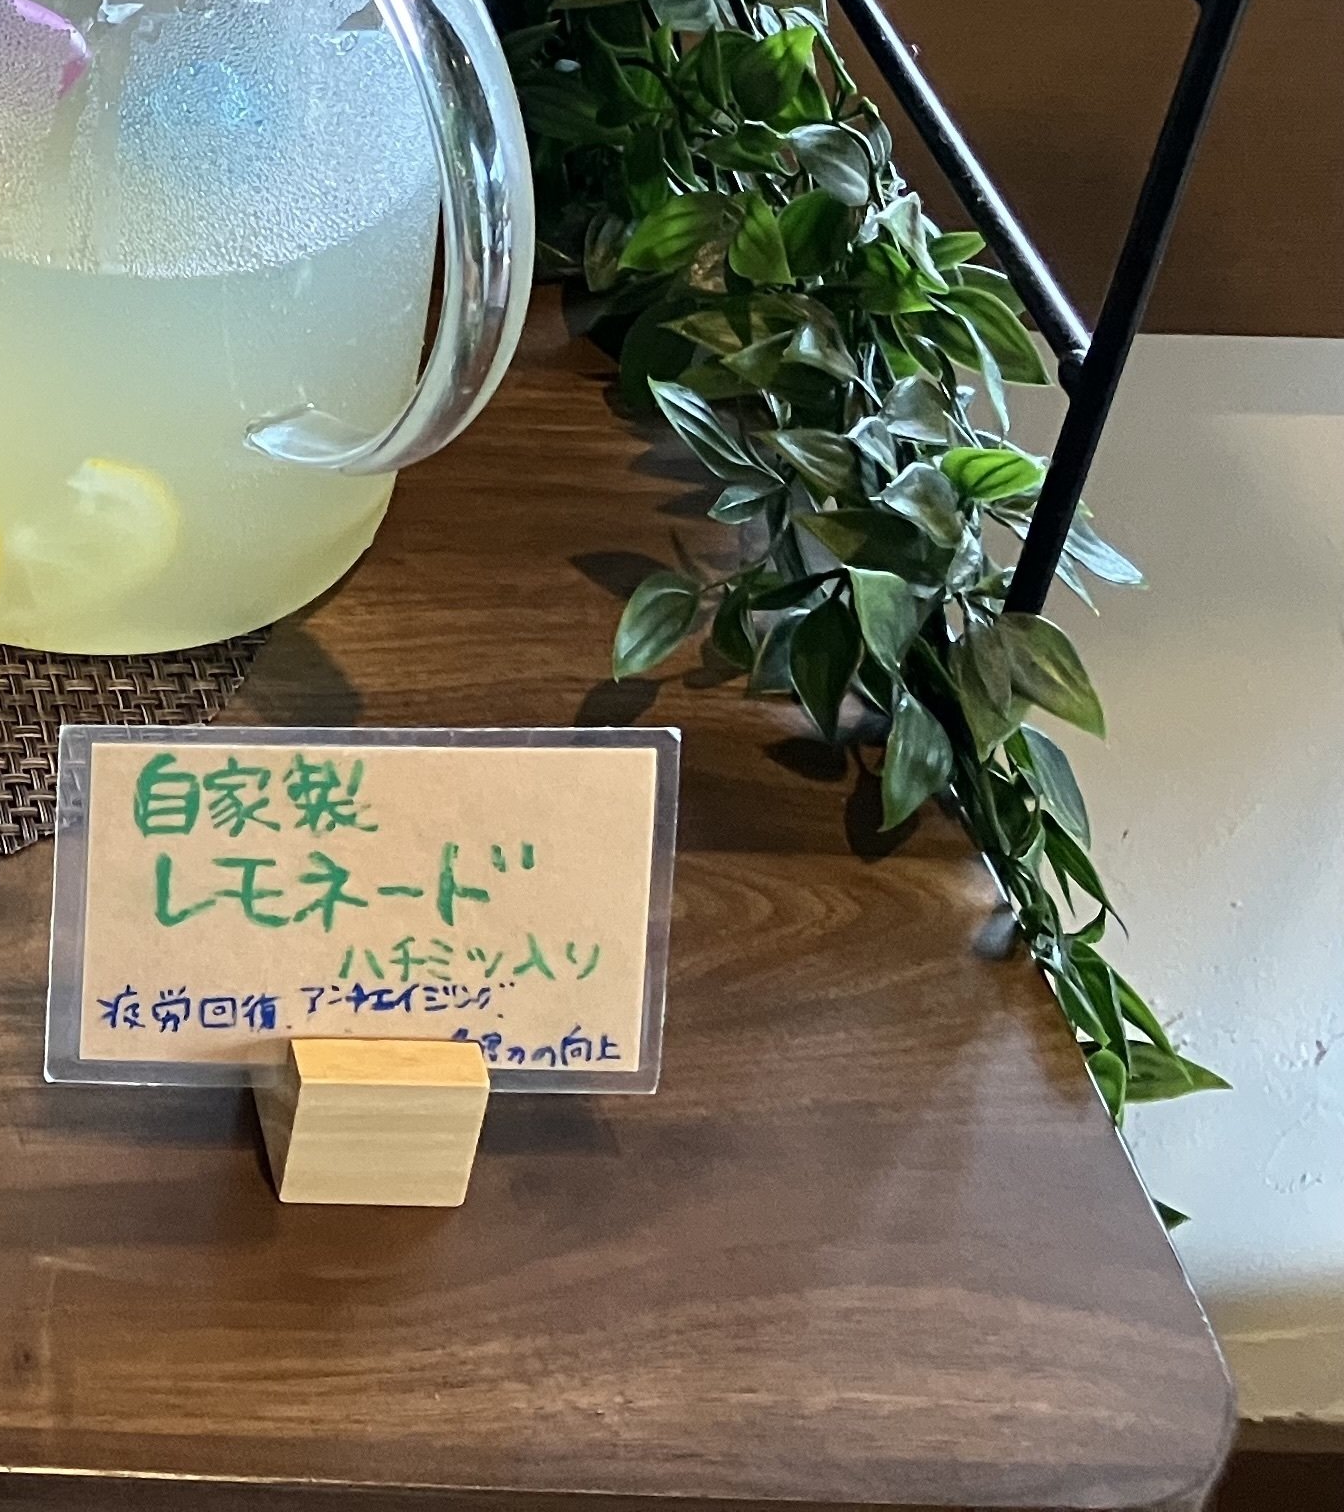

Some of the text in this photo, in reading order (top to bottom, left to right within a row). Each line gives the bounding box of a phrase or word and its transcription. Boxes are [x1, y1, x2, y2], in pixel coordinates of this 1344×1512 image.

[132, 752, 379, 837] 自家製
[154, 841, 536, 933] レモネード
[338, 932, 602, 982] ハチミツ入り
[452, 1025, 621, 1067] 力の向上
